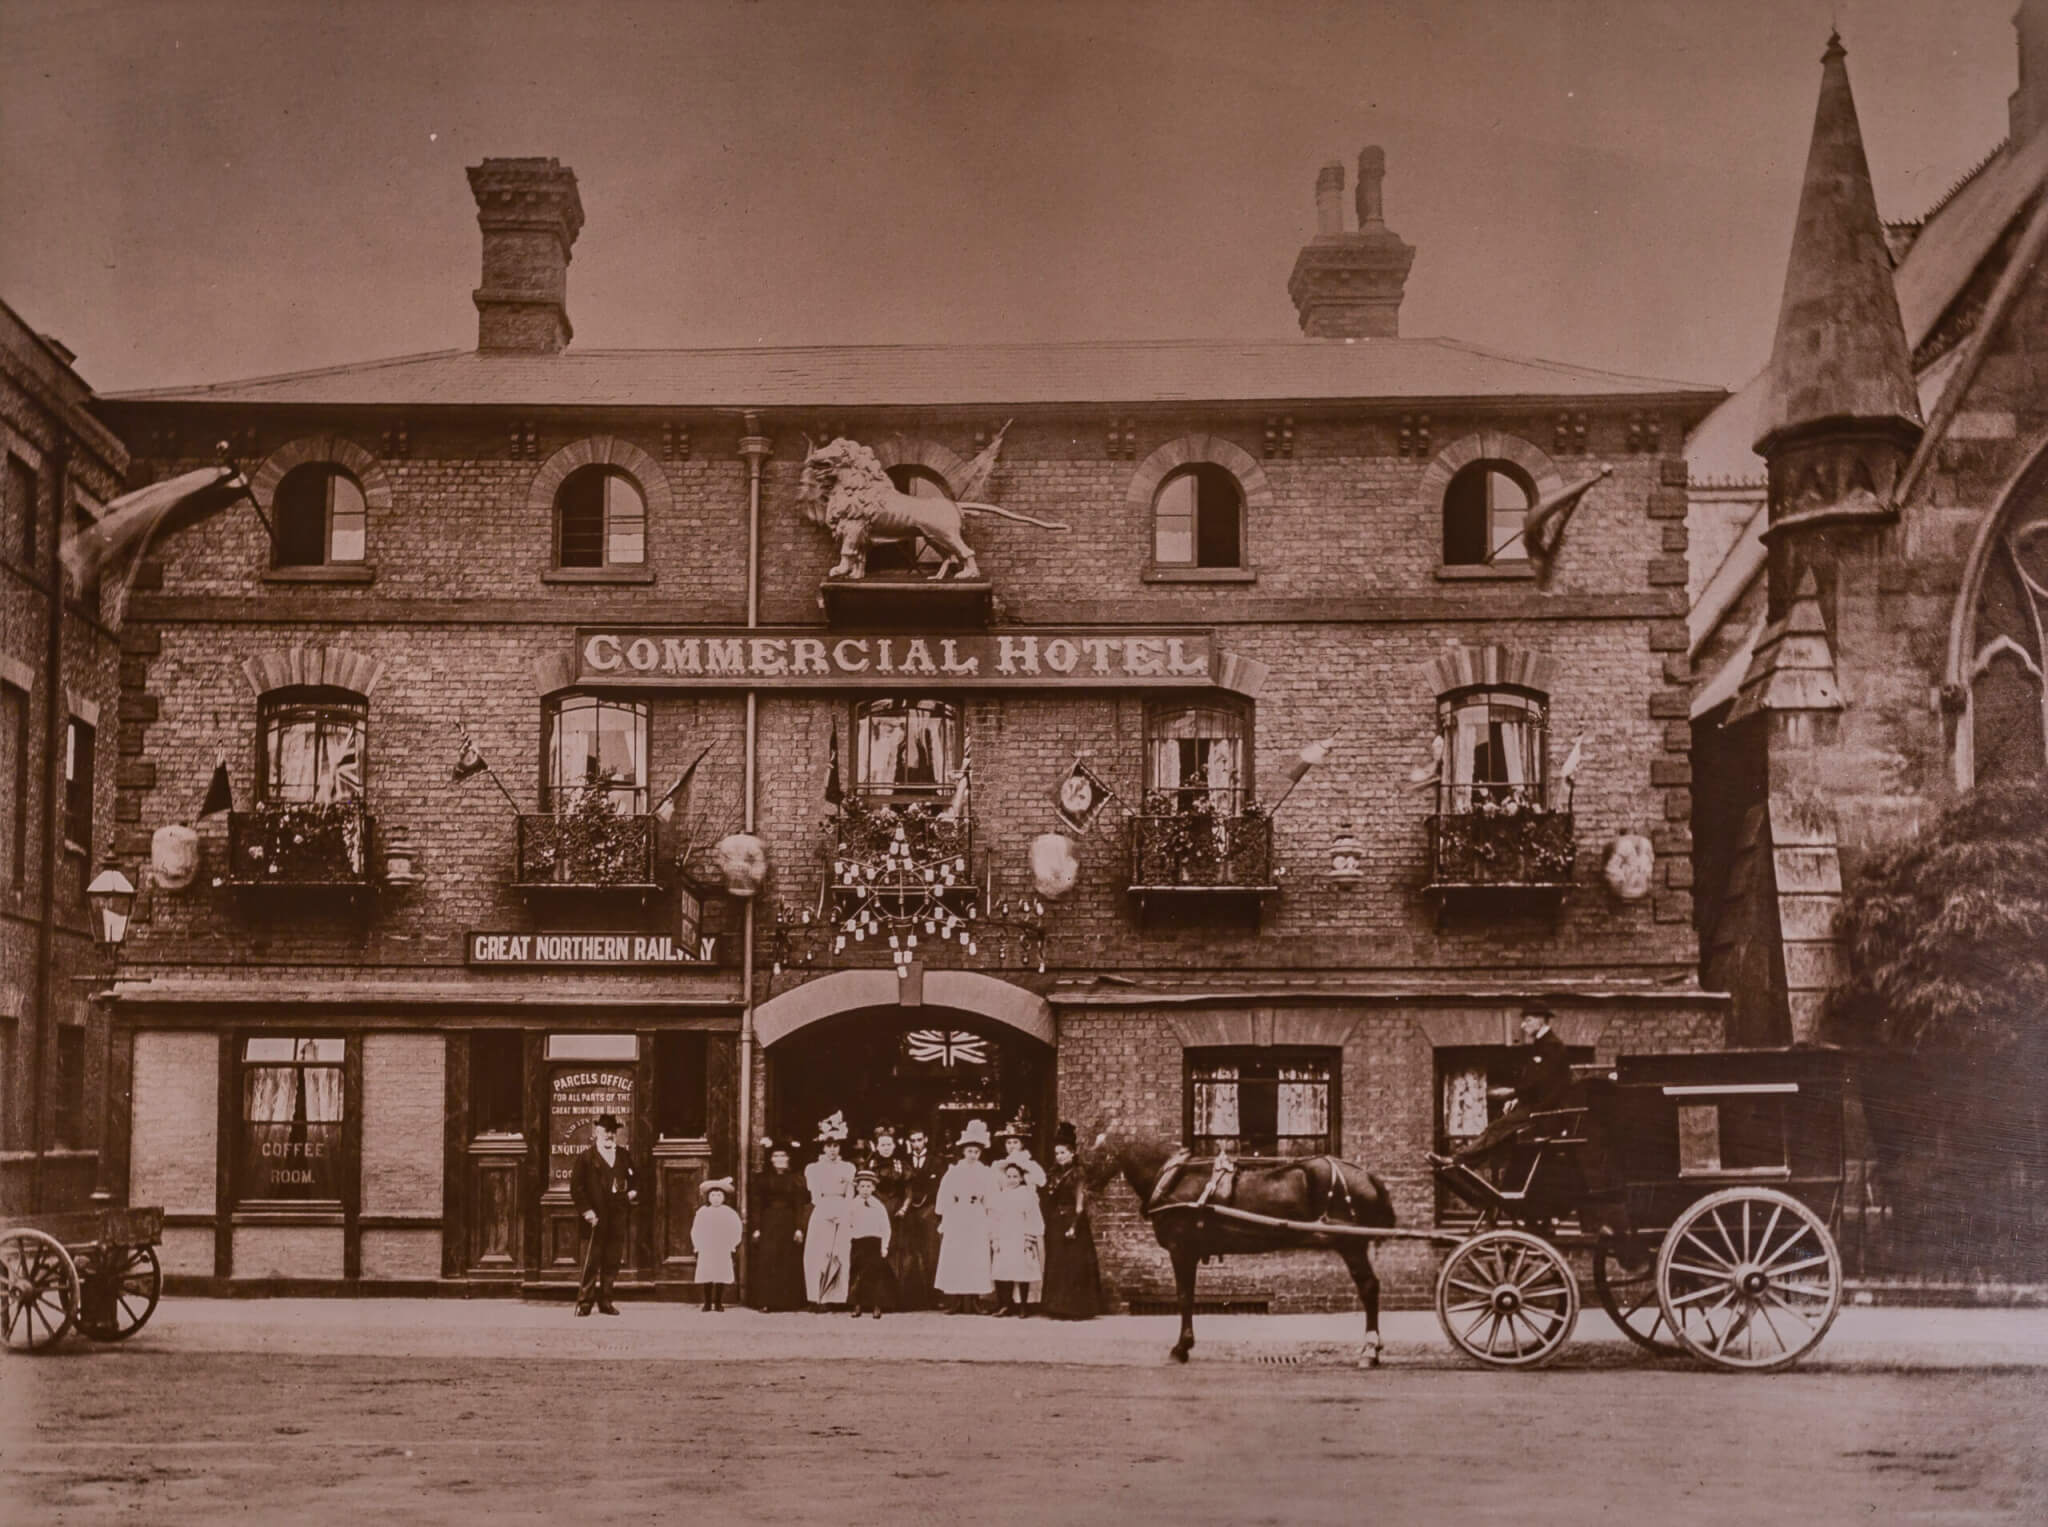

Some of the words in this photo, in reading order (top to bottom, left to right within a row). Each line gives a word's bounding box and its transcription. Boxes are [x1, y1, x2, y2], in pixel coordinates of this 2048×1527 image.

[584, 634, 979, 675] COMMERCIAL
[996, 636, 1208, 676] HOTEL
[475, 936, 531, 960] GREAT
[536, 936, 629, 961] NORTHERN
[634, 937, 715, 961] RAILY
[553, 1073, 597, 1091] PARCELS
[600, 1073, 633, 1091] OFFICE
[553, 1093, 567, 1102] FOR
[568, 1093, 580, 1102] ALL
[581, 1093, 604, 1102] PARTS
[606, 1093, 615, 1102] OF
[617, 1093, 631, 1102] THE
[262, 1143, 325, 1157] COFFEE
